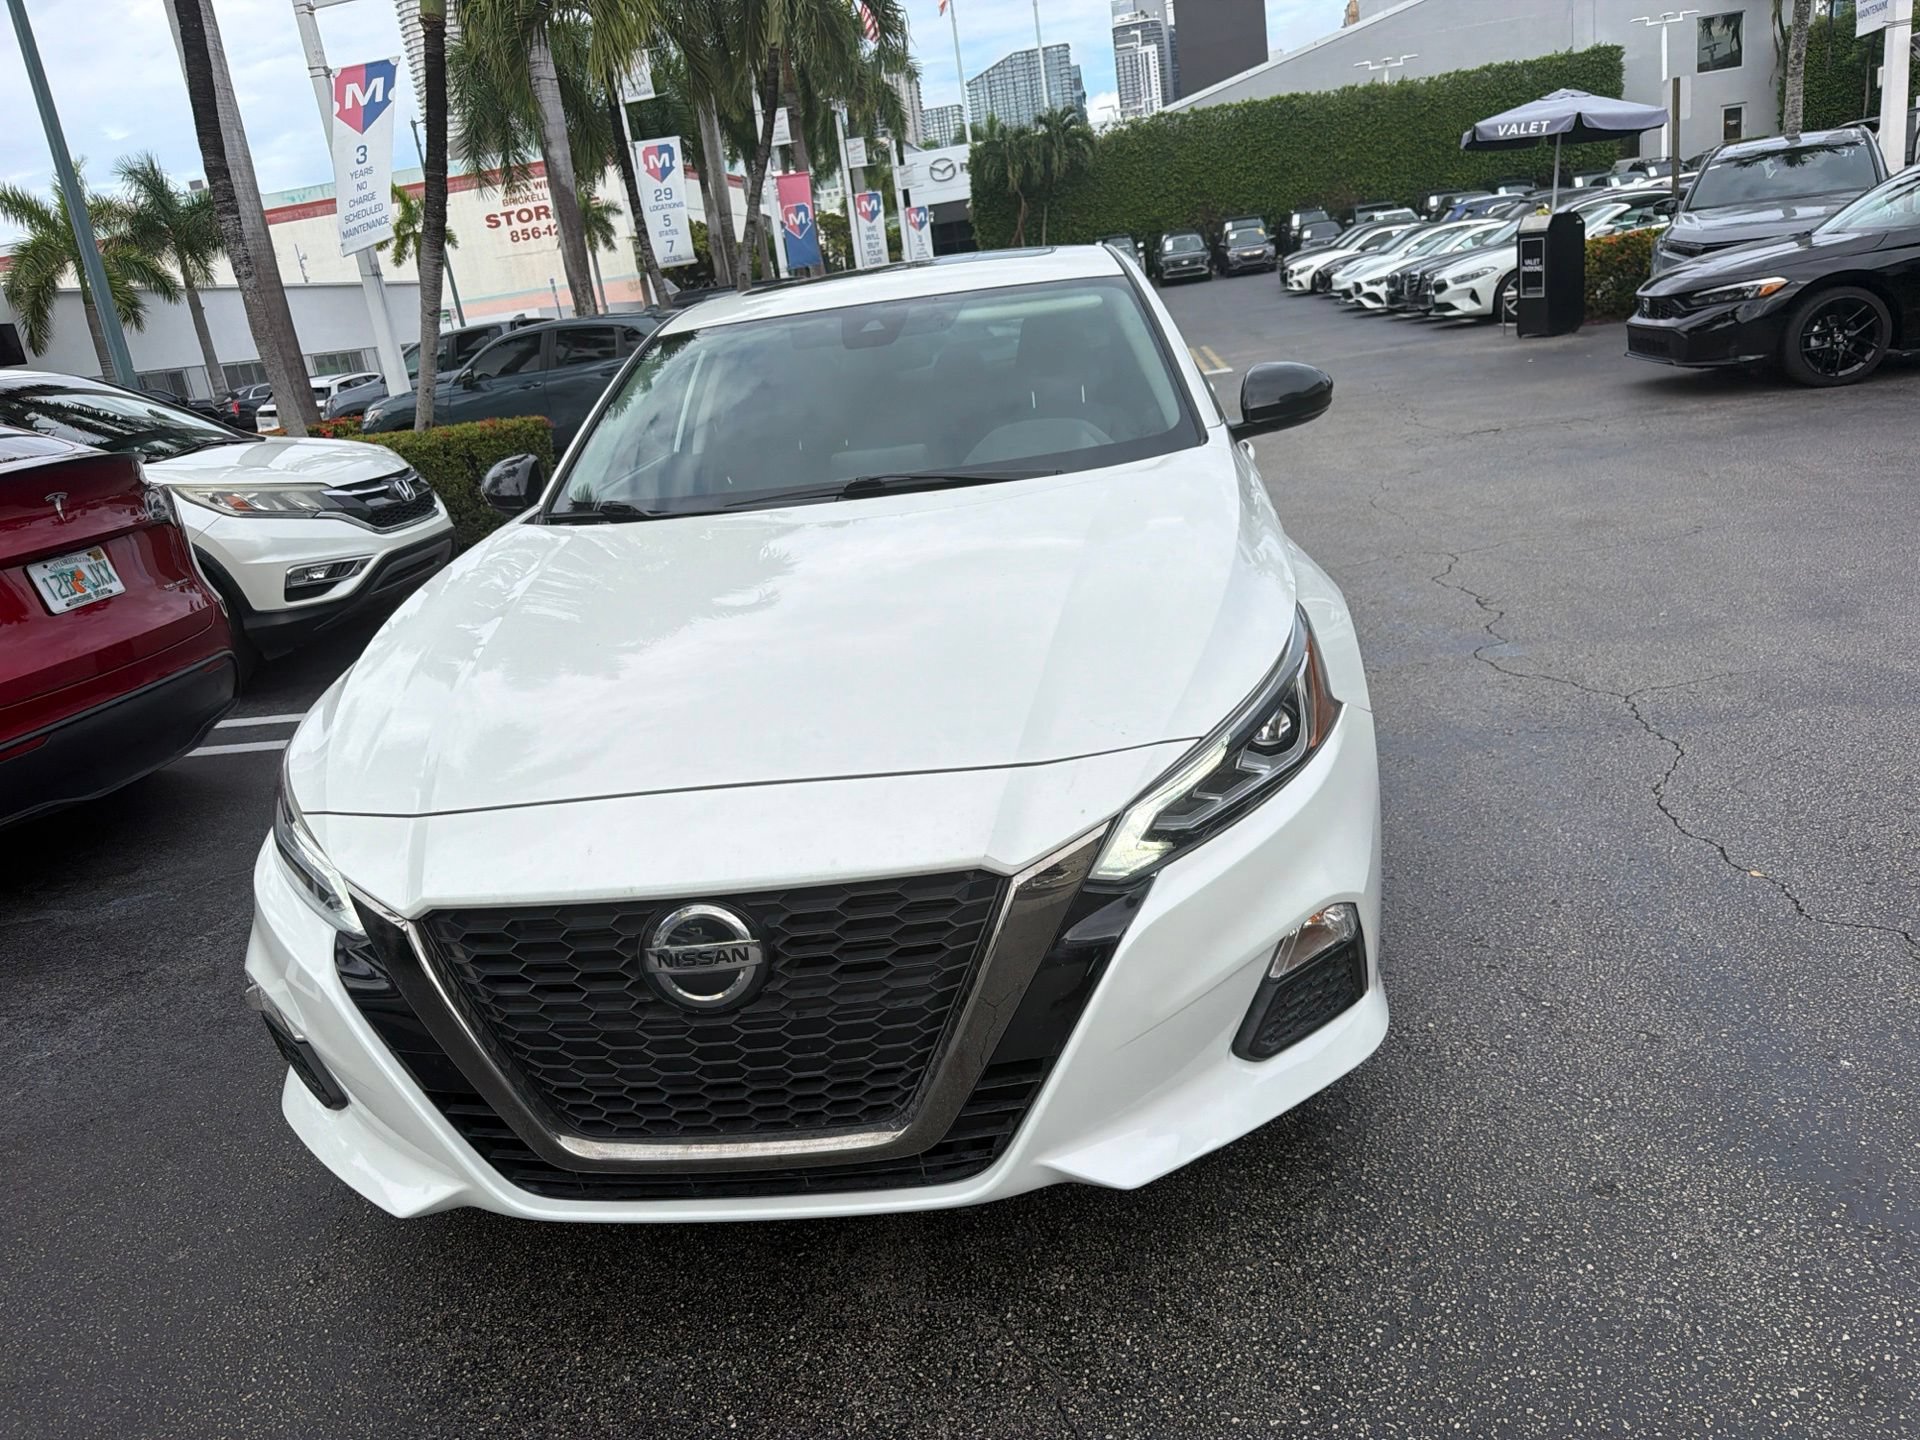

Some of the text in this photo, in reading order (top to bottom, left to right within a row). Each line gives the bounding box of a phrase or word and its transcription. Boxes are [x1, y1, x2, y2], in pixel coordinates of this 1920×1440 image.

[345, 77, 385, 110] M
[1497, 120, 1551, 137] VALET
[356, 145, 367, 165] 3
[648, 153, 671, 170] M
[350, 166, 374, 180] YEARS
[356, 181, 367, 192] NO
[654, 187, 673, 202] 29
[348, 191, 377, 208] CHARGE
[502, 193, 548, 207] BRICKELL
[649, 201, 685, 212] LOCATIONS
[861, 199, 878, 213] M
[344, 203, 384, 224] SCHEDULED
[485, 205, 552, 229] STOR
[663, 214, 672, 227] 5
[788, 212, 806, 226] M
[911, 212, 925, 224] M
[342, 214, 390, 239] MAINTENANCE
[666, 240, 674, 253] 7
[87, 560, 118, 589] JXX
[657, 946, 750, 968] NISSAN
